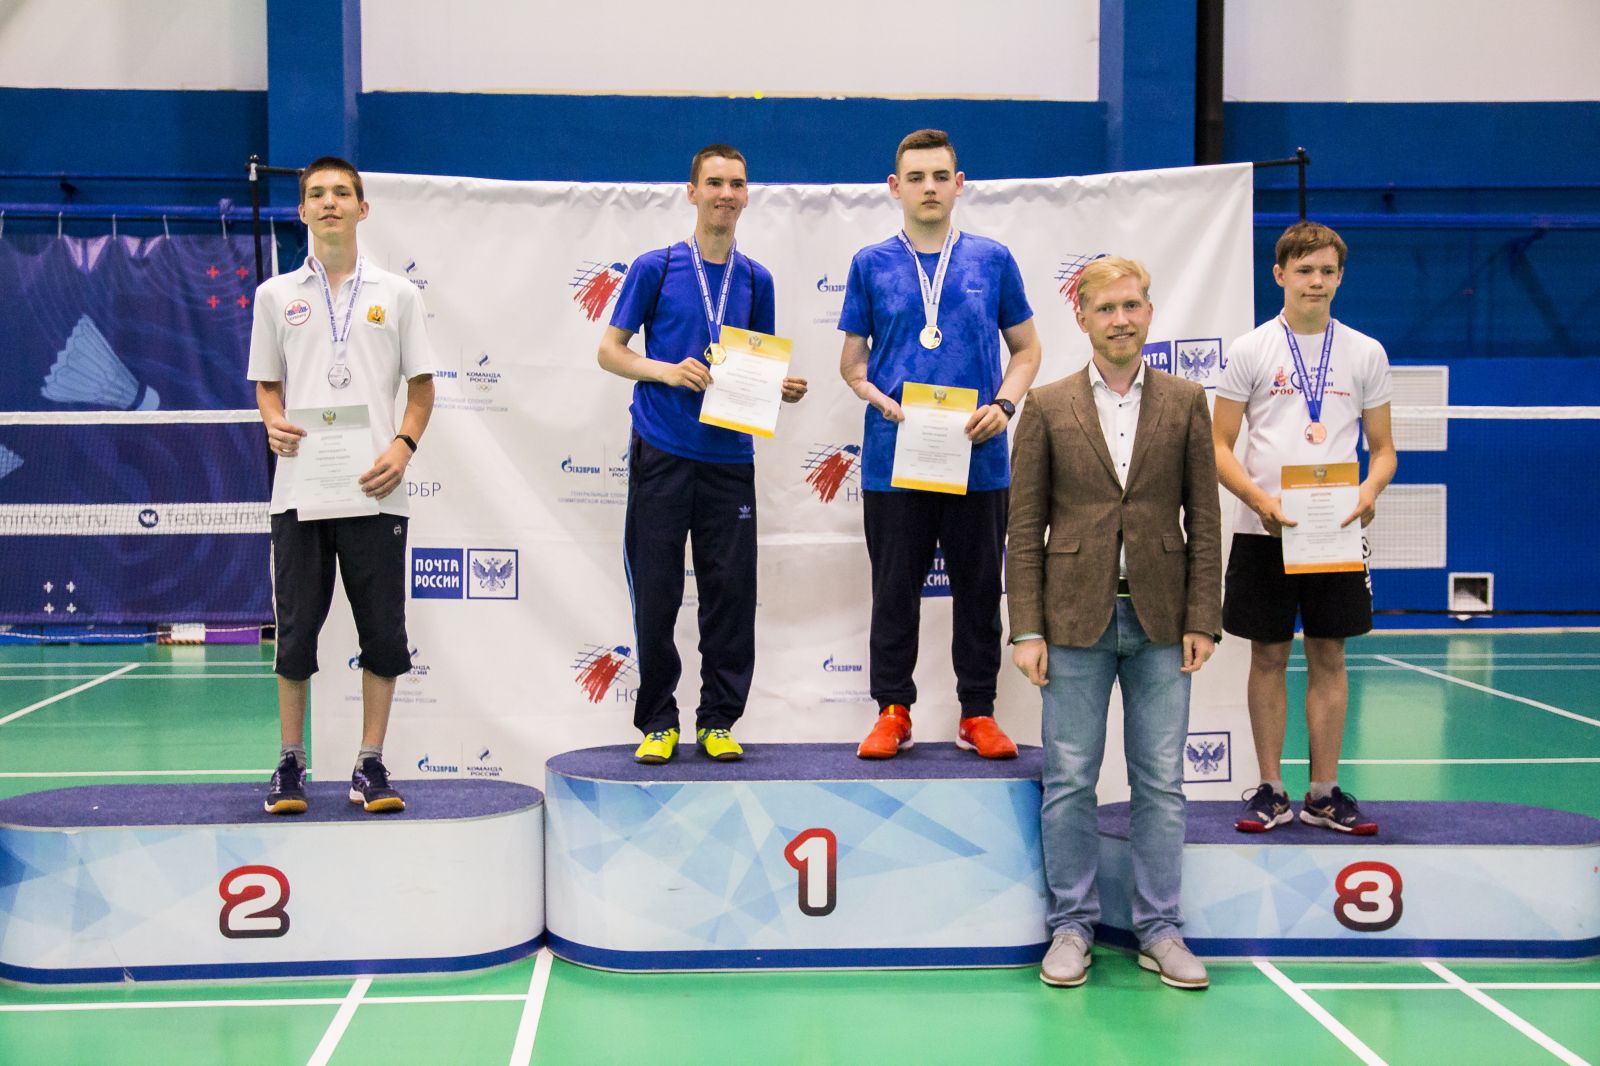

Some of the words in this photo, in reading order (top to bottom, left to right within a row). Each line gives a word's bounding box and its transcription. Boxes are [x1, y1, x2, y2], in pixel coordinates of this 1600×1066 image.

[1142, 352, 1168, 366] ЧТА
[407, 481, 441, 497] ФБР
[415, 558, 459, 572] ПОЧТА
[415, 574, 459, 588] РОССИИ
[784, 828, 837, 917] 1
[219, 865, 290, 938] 2
[1334, 861, 1403, 932] 3
